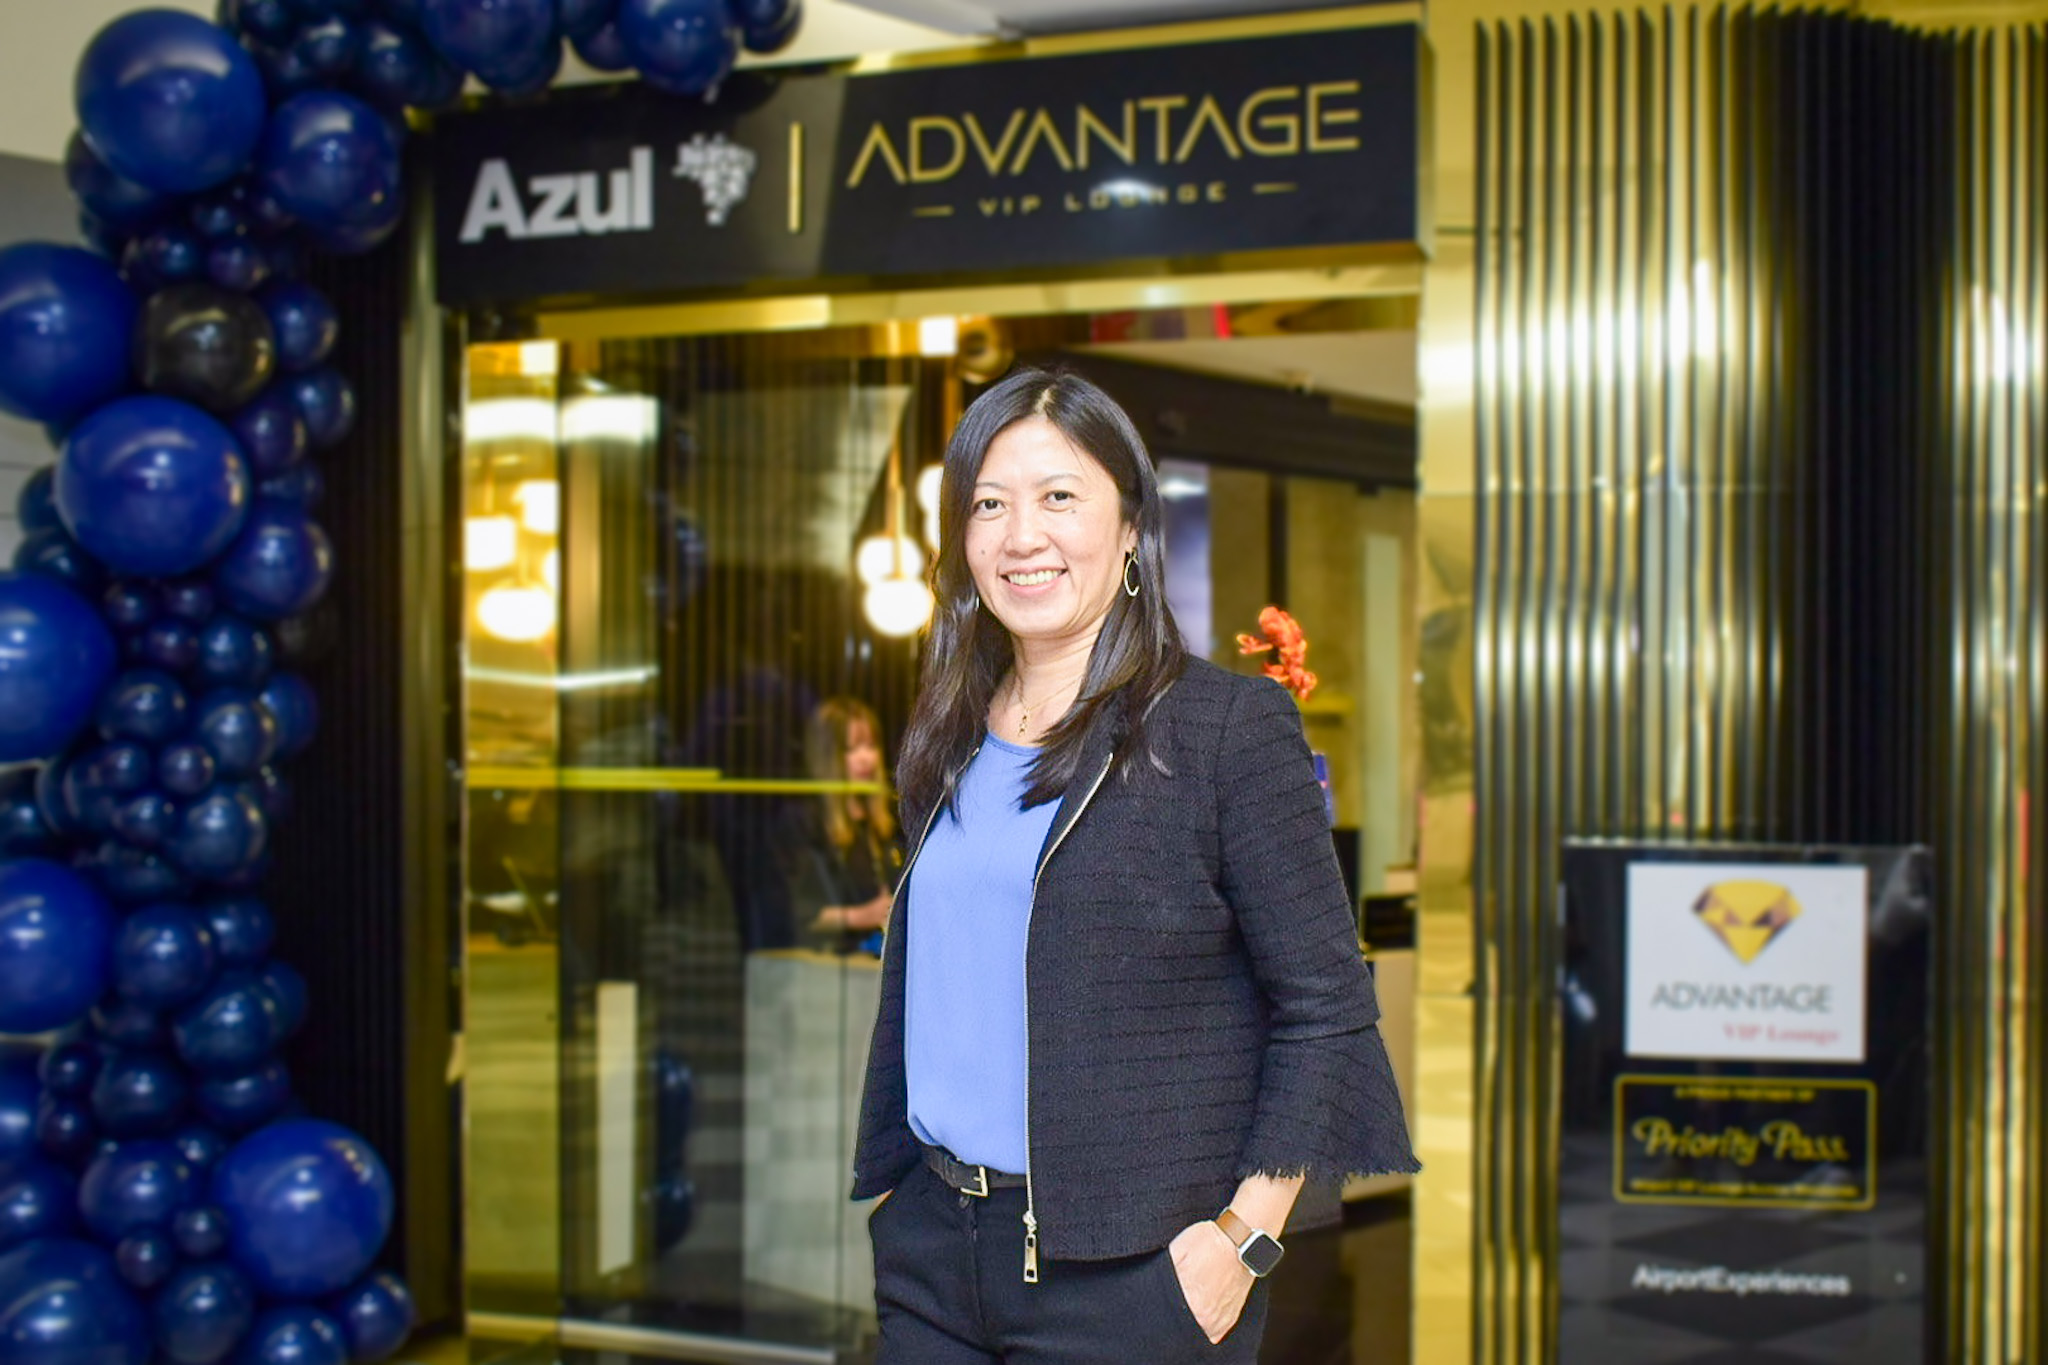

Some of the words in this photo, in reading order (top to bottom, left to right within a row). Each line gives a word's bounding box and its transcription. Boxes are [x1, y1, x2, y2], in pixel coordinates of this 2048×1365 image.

[847, 81, 1360, 188] ADVANTAGE
[459, 147, 653, 243] Azul
[979, 195, 1041, 217] VIP
[1064, 181, 1227, 213] LOUNGE
[1652, 982, 1832, 1013] ADVANTAGE
[1724, 1023, 1762, 1040] VIP
[1632, 1117, 1759, 1166] Priority
[1760, 1120, 1850, 1161] Pass
[1633, 1264, 1851, 1296] AirportExperiences
